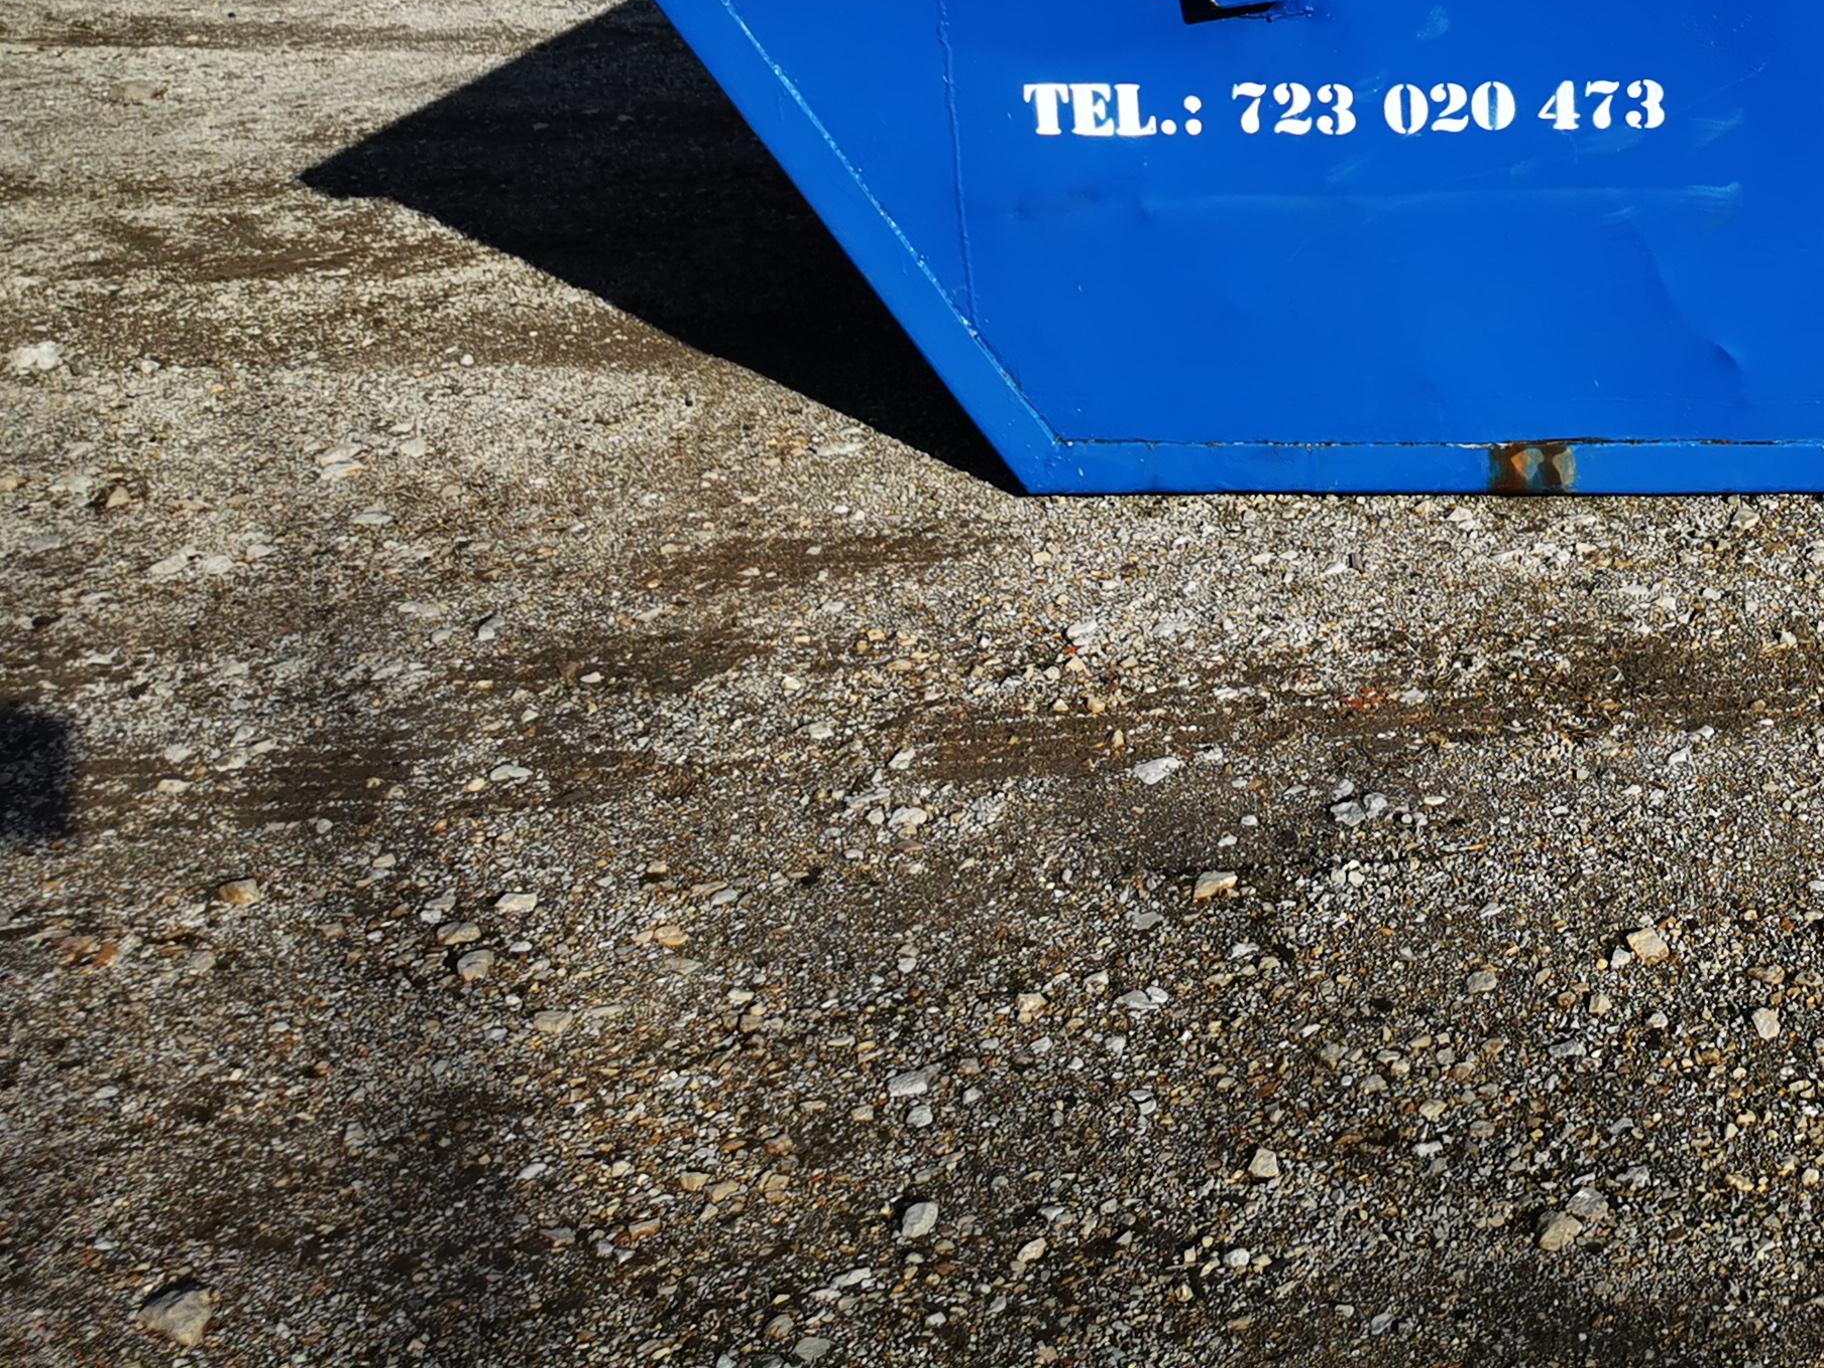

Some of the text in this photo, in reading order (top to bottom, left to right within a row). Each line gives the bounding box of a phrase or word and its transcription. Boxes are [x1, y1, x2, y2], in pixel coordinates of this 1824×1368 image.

[1022, 79, 1666, 138] TEL.: 723 020 473
